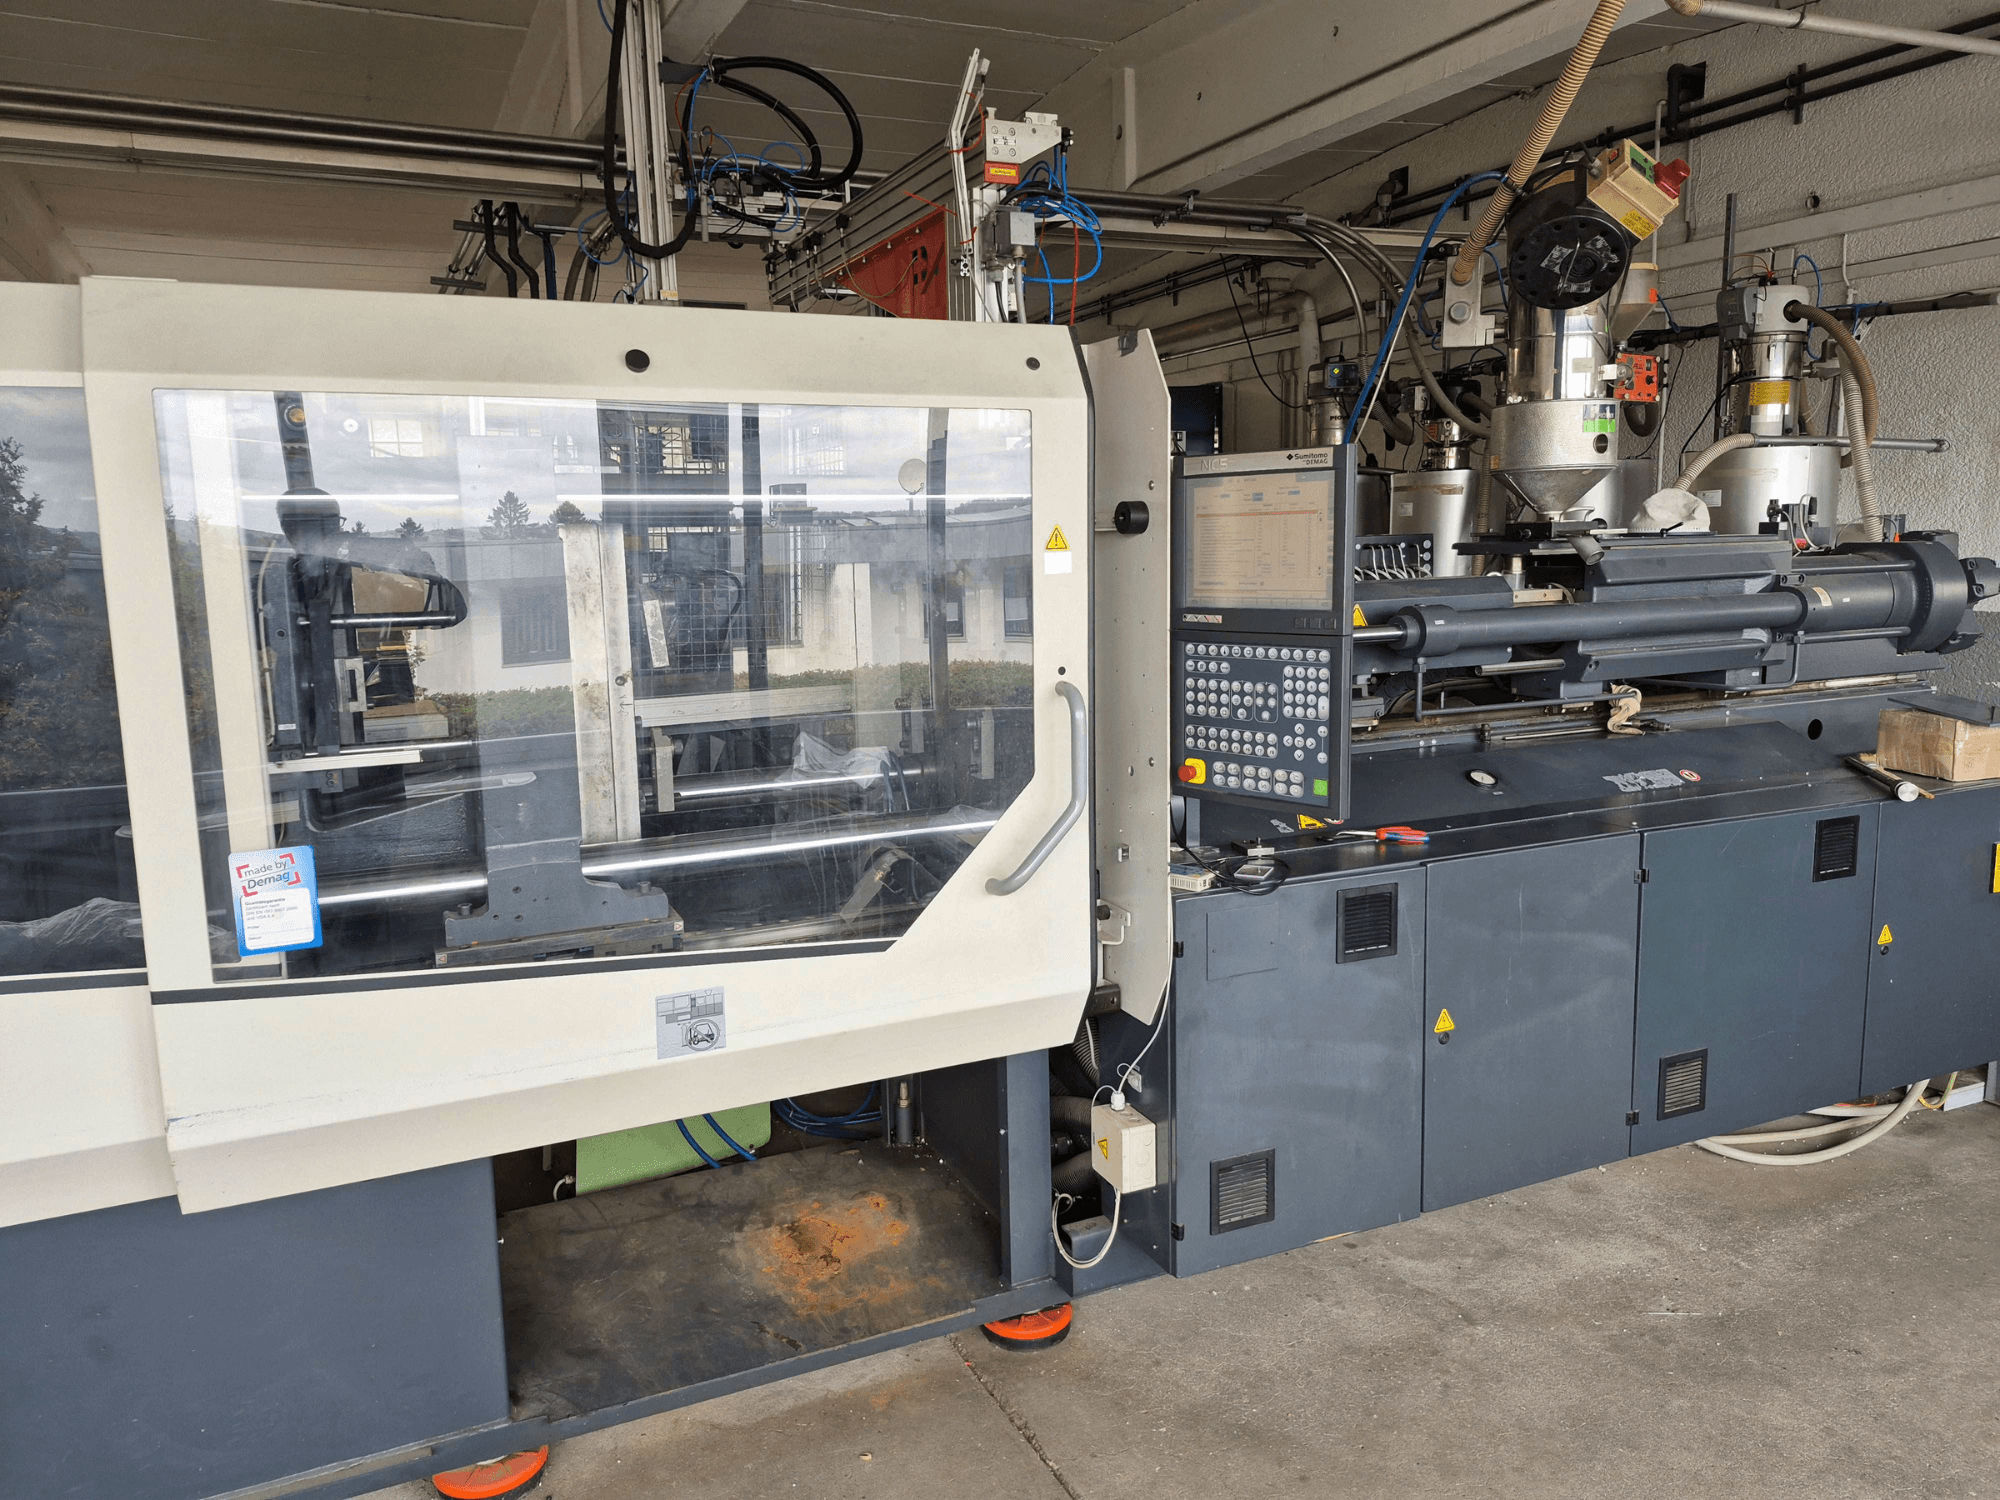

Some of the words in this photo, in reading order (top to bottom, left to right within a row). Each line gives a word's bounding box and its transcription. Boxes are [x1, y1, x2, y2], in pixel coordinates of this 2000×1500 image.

[1294, 452, 1328, 460] Sumitomo
[244, 863, 273, 877] made
[274, 860, 287, 870] by
[247, 871, 290, 889] Demag
